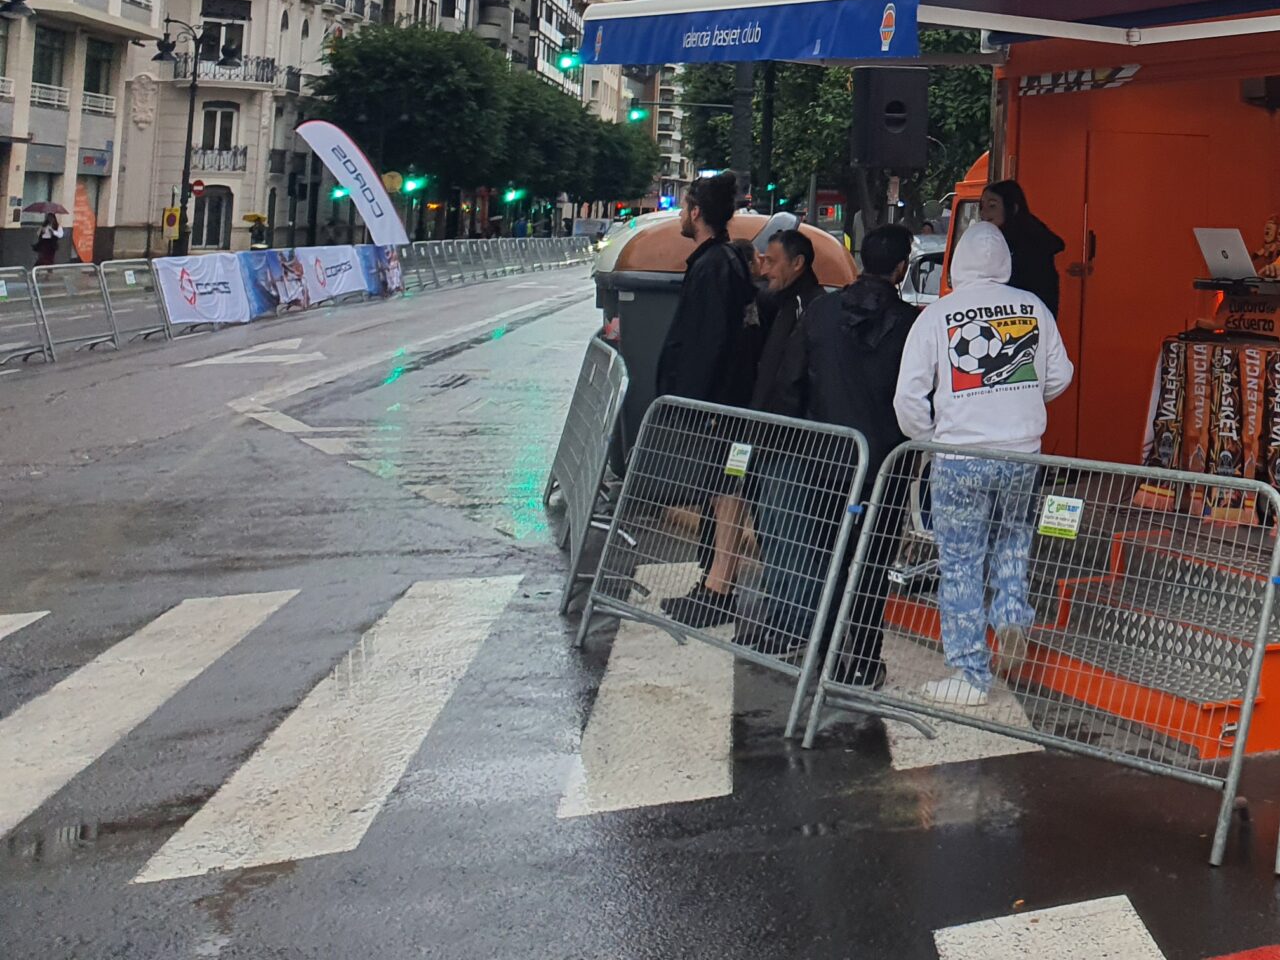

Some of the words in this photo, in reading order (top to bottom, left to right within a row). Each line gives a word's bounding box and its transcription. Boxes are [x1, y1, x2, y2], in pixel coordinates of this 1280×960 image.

[741, 20, 762, 44] club
[945, 304, 1017, 326] FOOTBALL
[1020, 303, 1035, 316] 87
[996, 319, 1033, 328] PANINI
[1225, 314, 1275, 332] Esfuerzo
[1159, 342, 1178, 421] VALENCIA
[1193, 344, 1208, 428] VALENCIA
[1245, 348, 1261, 435] VALENCIA
[1218, 372, 1238, 441] BASKET
